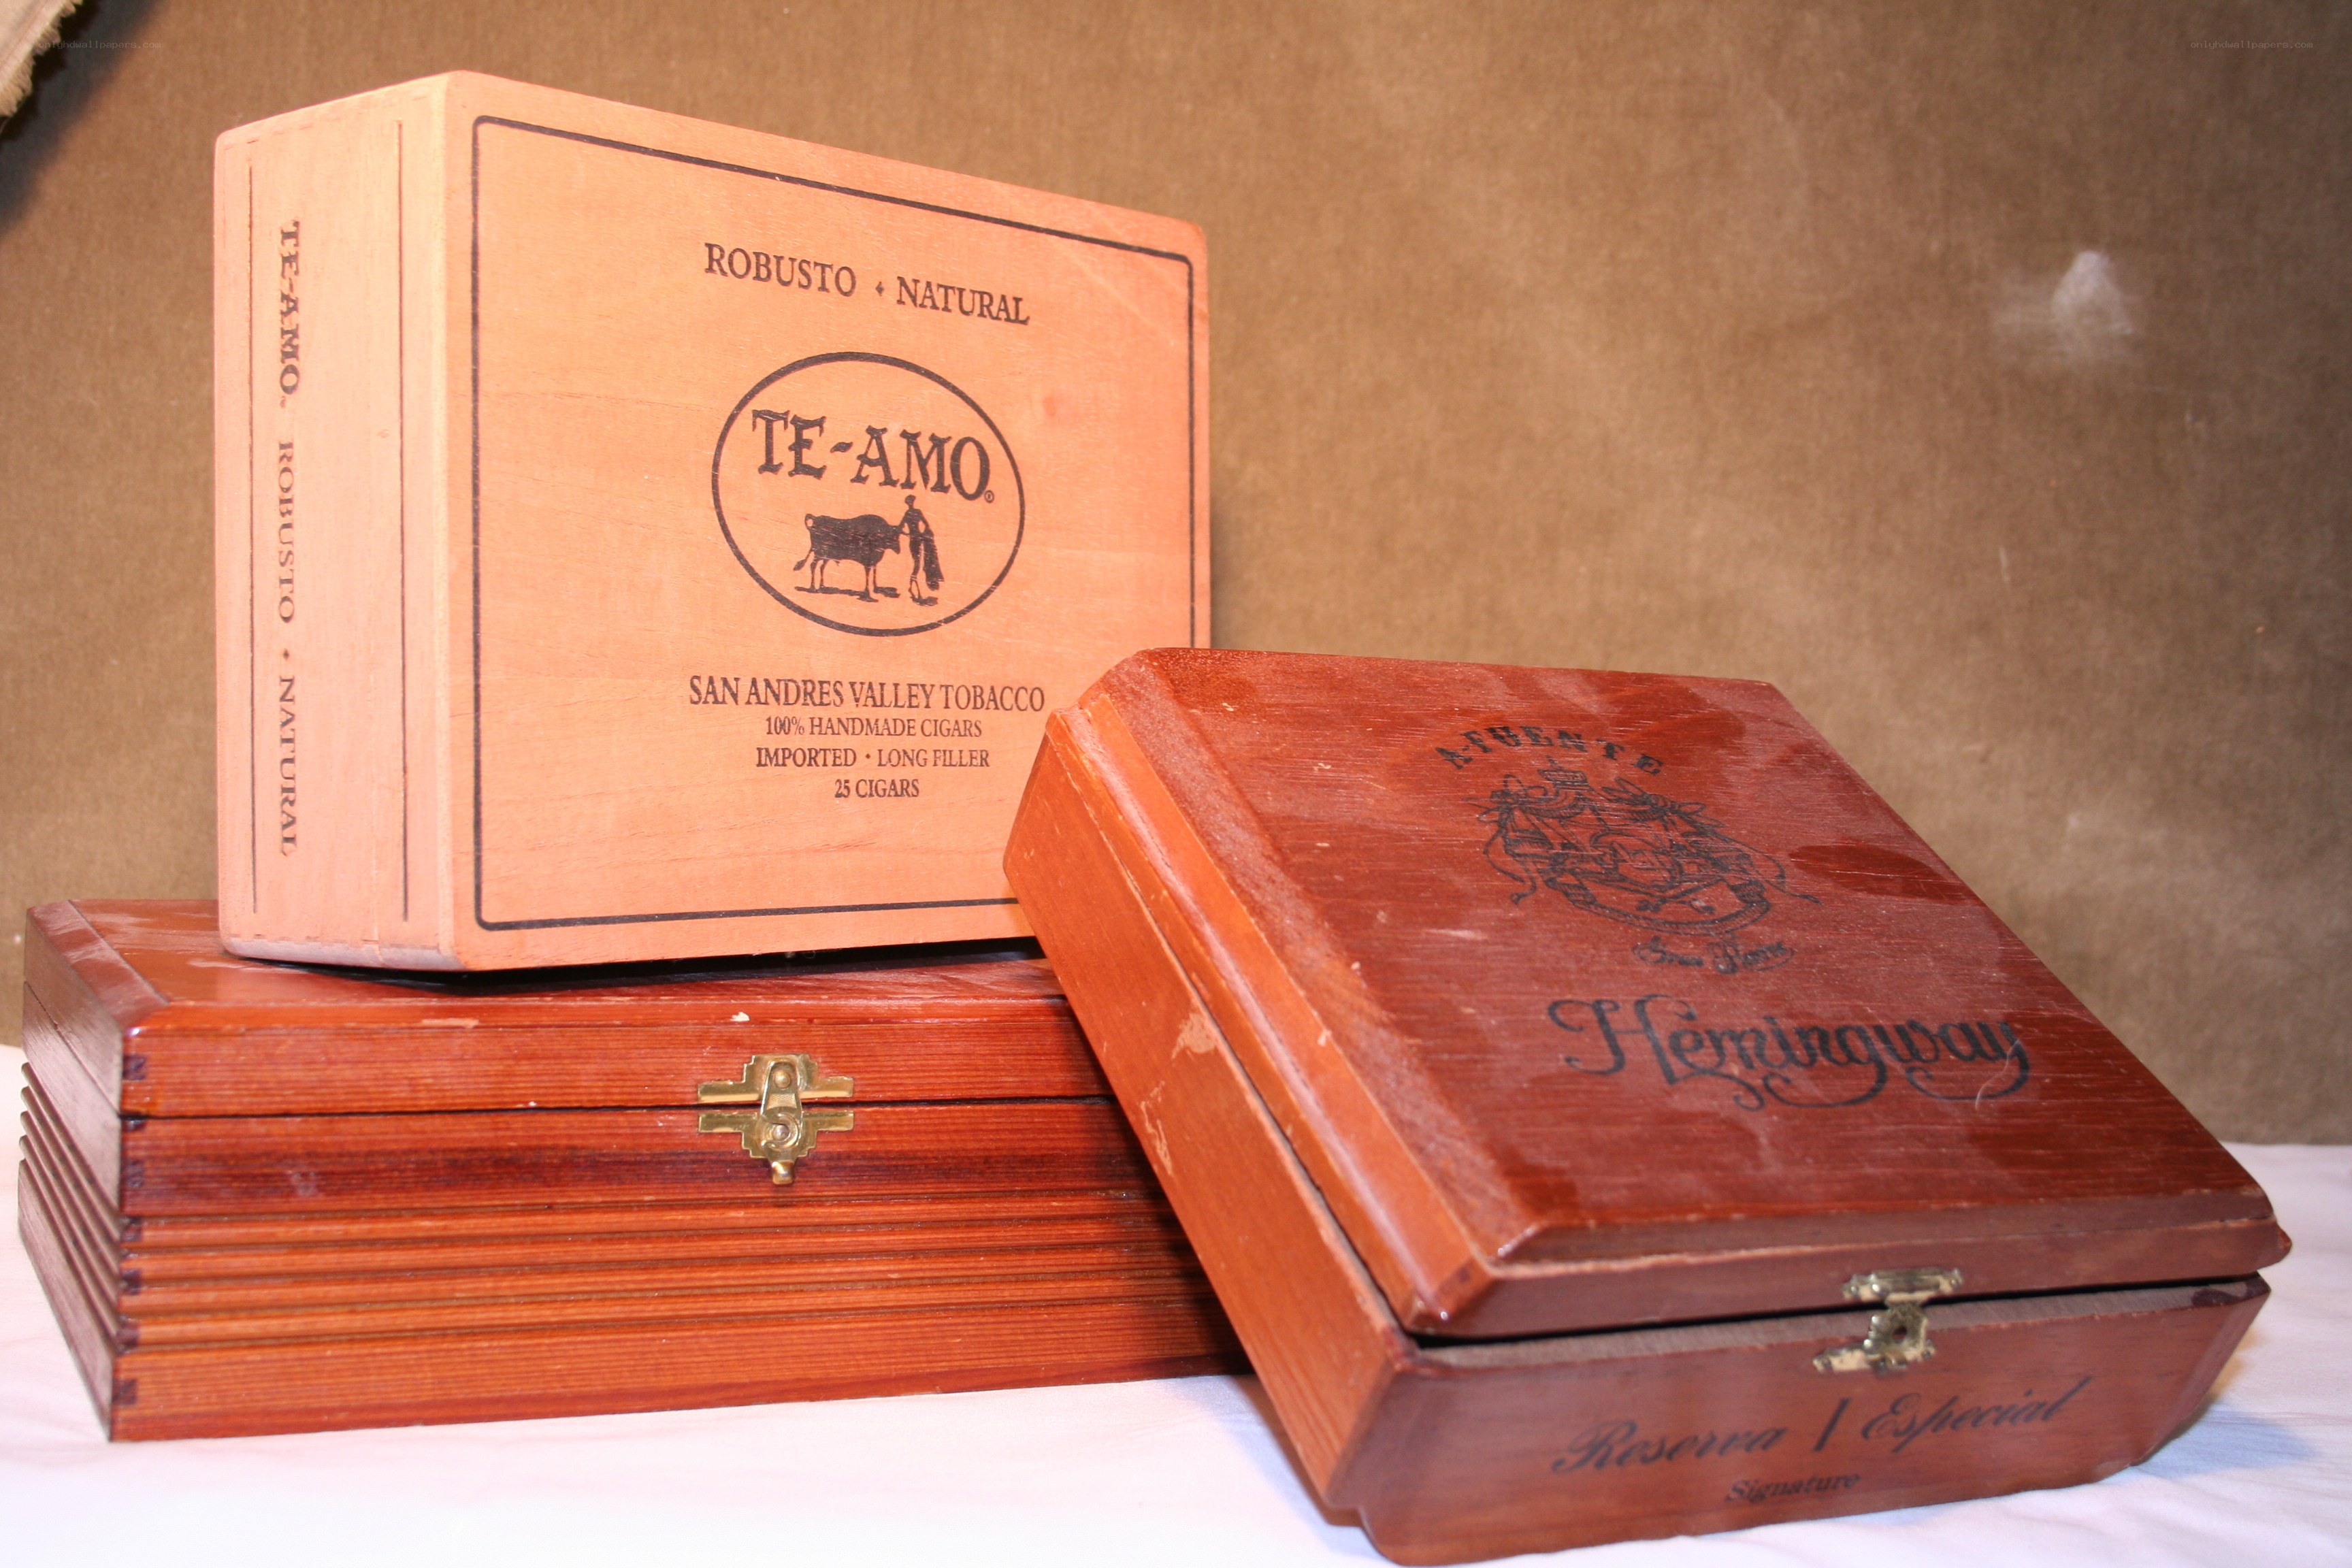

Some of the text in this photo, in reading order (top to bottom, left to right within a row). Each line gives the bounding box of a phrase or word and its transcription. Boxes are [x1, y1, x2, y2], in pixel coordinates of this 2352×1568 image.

[704, 243, 1030, 325] ROBUSTO NATURAL
[751, 409, 991, 501] TE-AMO
[278, 220, 300, 858] TE-AMO ROBUSTO NATURAL
[689, 675, 1045, 712] SAN ANDRES VALLEY TOBACCO
[766, 717, 982, 737] 100% HANDMADE CIGARS
[755, 748, 990, 768] IMPORTED LONG FILLER
[834, 779, 920, 798] 25 CIGARS
[1547, 994, 2031, 1111] Hemingway
[1552, 1421, 1788, 1474] Reserva
[1861, 1377, 2094, 1453] Especial
[1725, 1473, 1861, 1502] Signature
